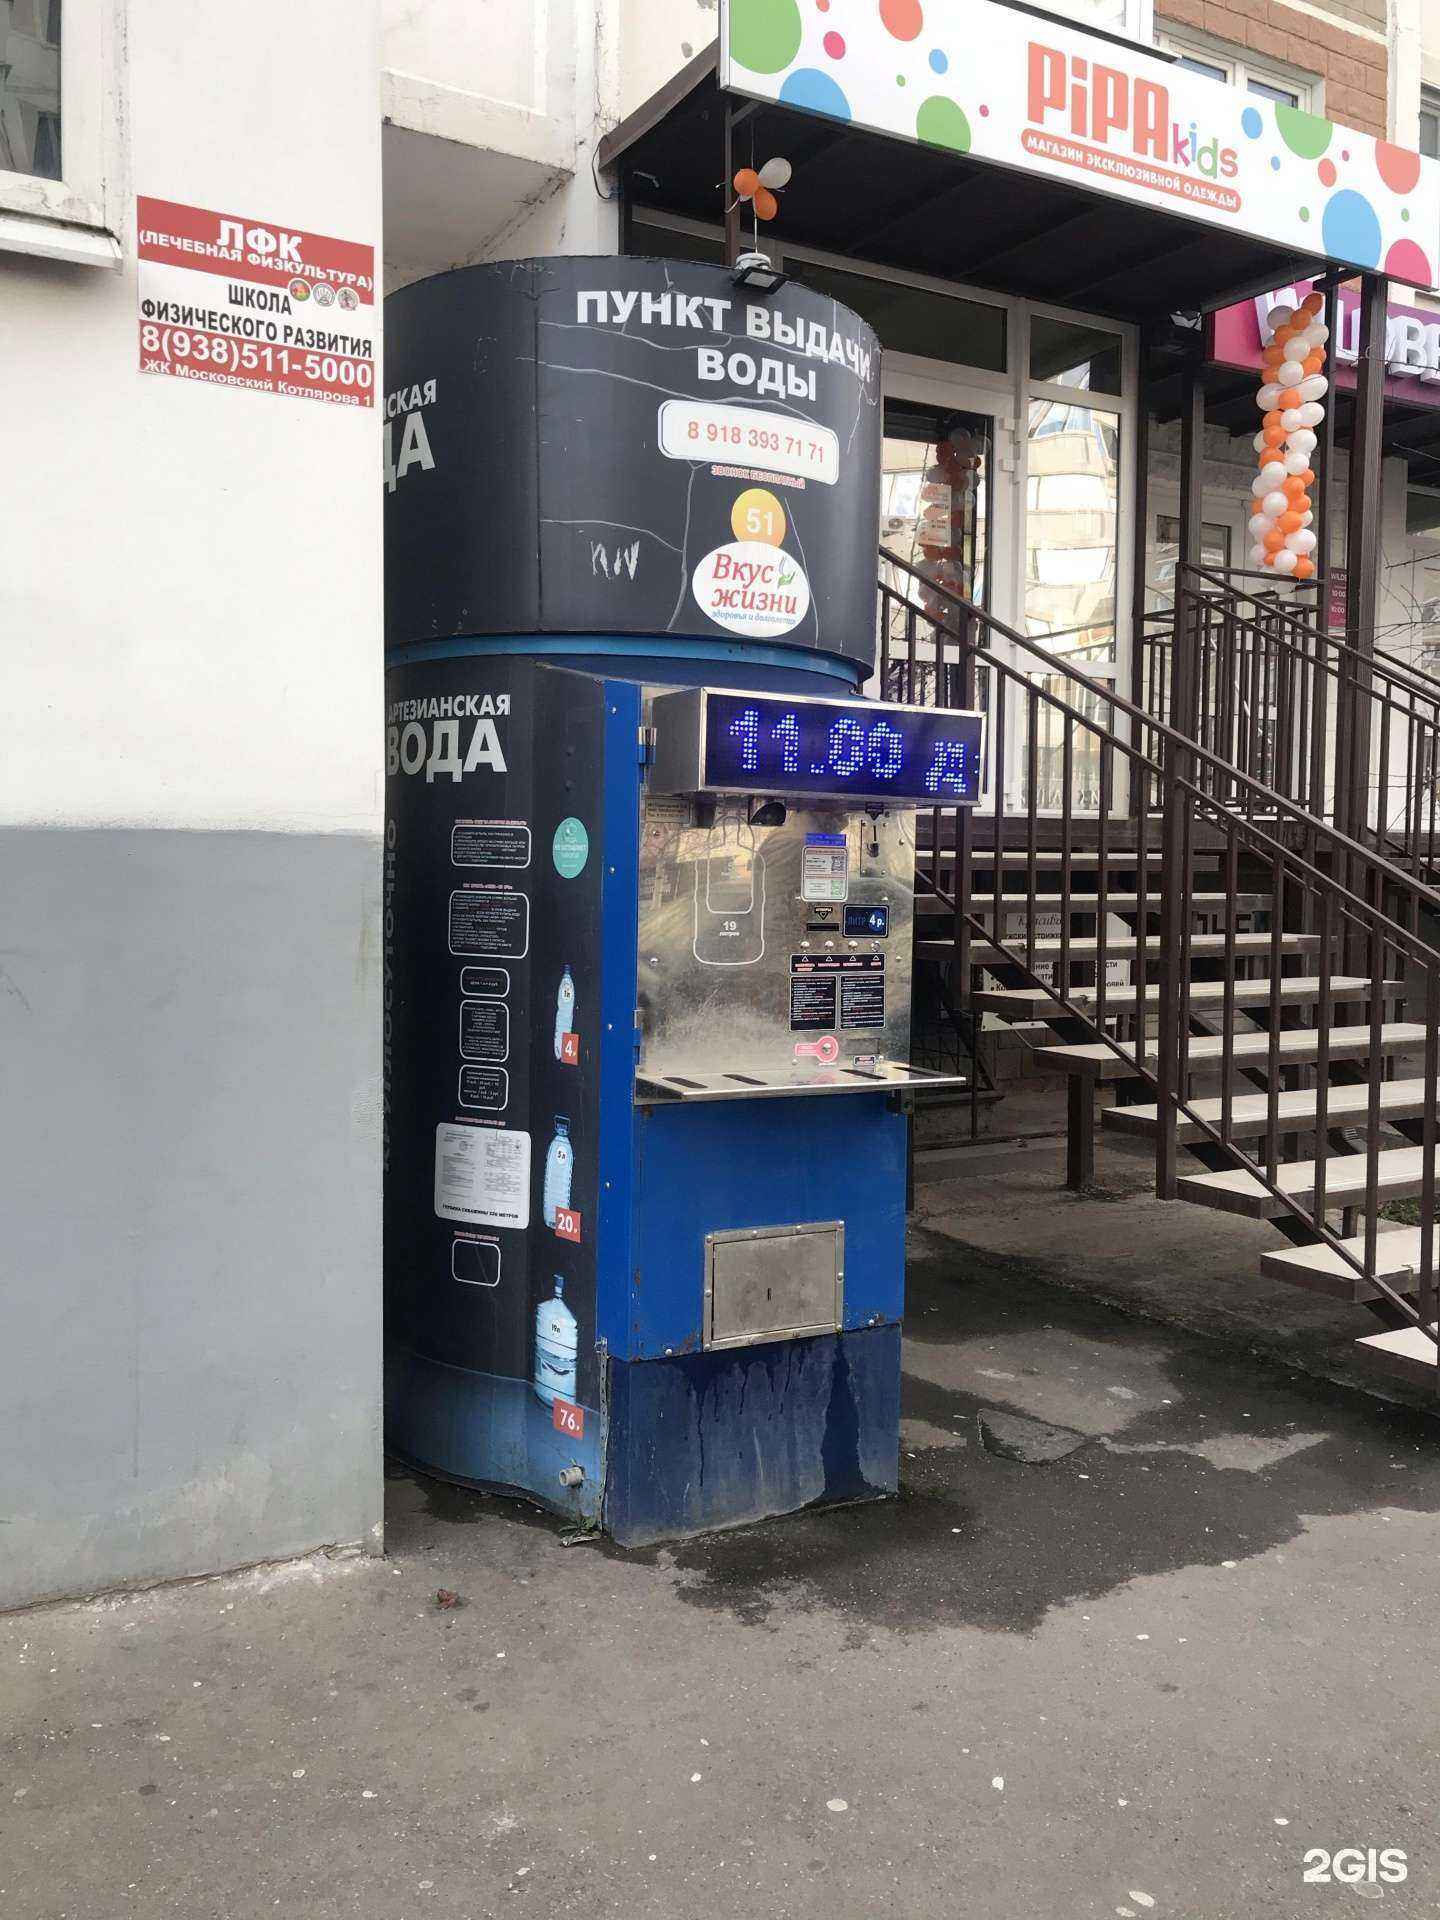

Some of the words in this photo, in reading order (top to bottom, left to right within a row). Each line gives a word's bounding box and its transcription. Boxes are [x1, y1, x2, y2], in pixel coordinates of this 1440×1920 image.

[1027, 135, 1084, 162] МАГАЗИН
[1087, 153, 1181, 192] ЭКСКЛЮЗИВНОЙ
[1183, 181, 1238, 209] ОДЕЖДЫ
[1172, 122, 1238, 179] kids
[139, 229, 242, 263] (ЛЕЧЕБНАЯ
[247, 252, 373, 292] ФИЗКУЛЬТУРА)
[216, 219, 302, 263] ЛФК
[228, 284, 292, 315] ШКОЛА
[141, 299, 277, 341] ФИЗИЧЕСКОГО
[283, 325, 372, 358] РАЗВИТИЯ
[577, 290, 731, 332] ПУНКТ
[746, 304, 873, 381] ВЫДАЧИ
[142, 326, 371, 388] 8(938)511-5000
[697, 348, 817, 402] ВОДЫ
[143, 359, 170, 374] ЖК
[175, 364, 273, 391] Московский
[278, 381, 360, 405] Котлярова
[364, 395, 371, 406] 1
[383, 378, 437, 421] СКАЯ
[688, 421, 700, 439] 8
[706, 424, 741, 444] 918
[748, 429, 780, 451] 393
[785, 437, 802, 456] 71
[808, 443, 824, 463] 71
[746, 508, 774, 536] 51
[712, 553, 775, 589] Вкус
[711, 588, 799, 615] жизни
[387, 694, 511, 723] АРТЕЗИАНСКАЯ
[387, 719, 508, 783] ВОДА
[723, 921, 737, 931] 19
[869, 914, 876, 925] 4
